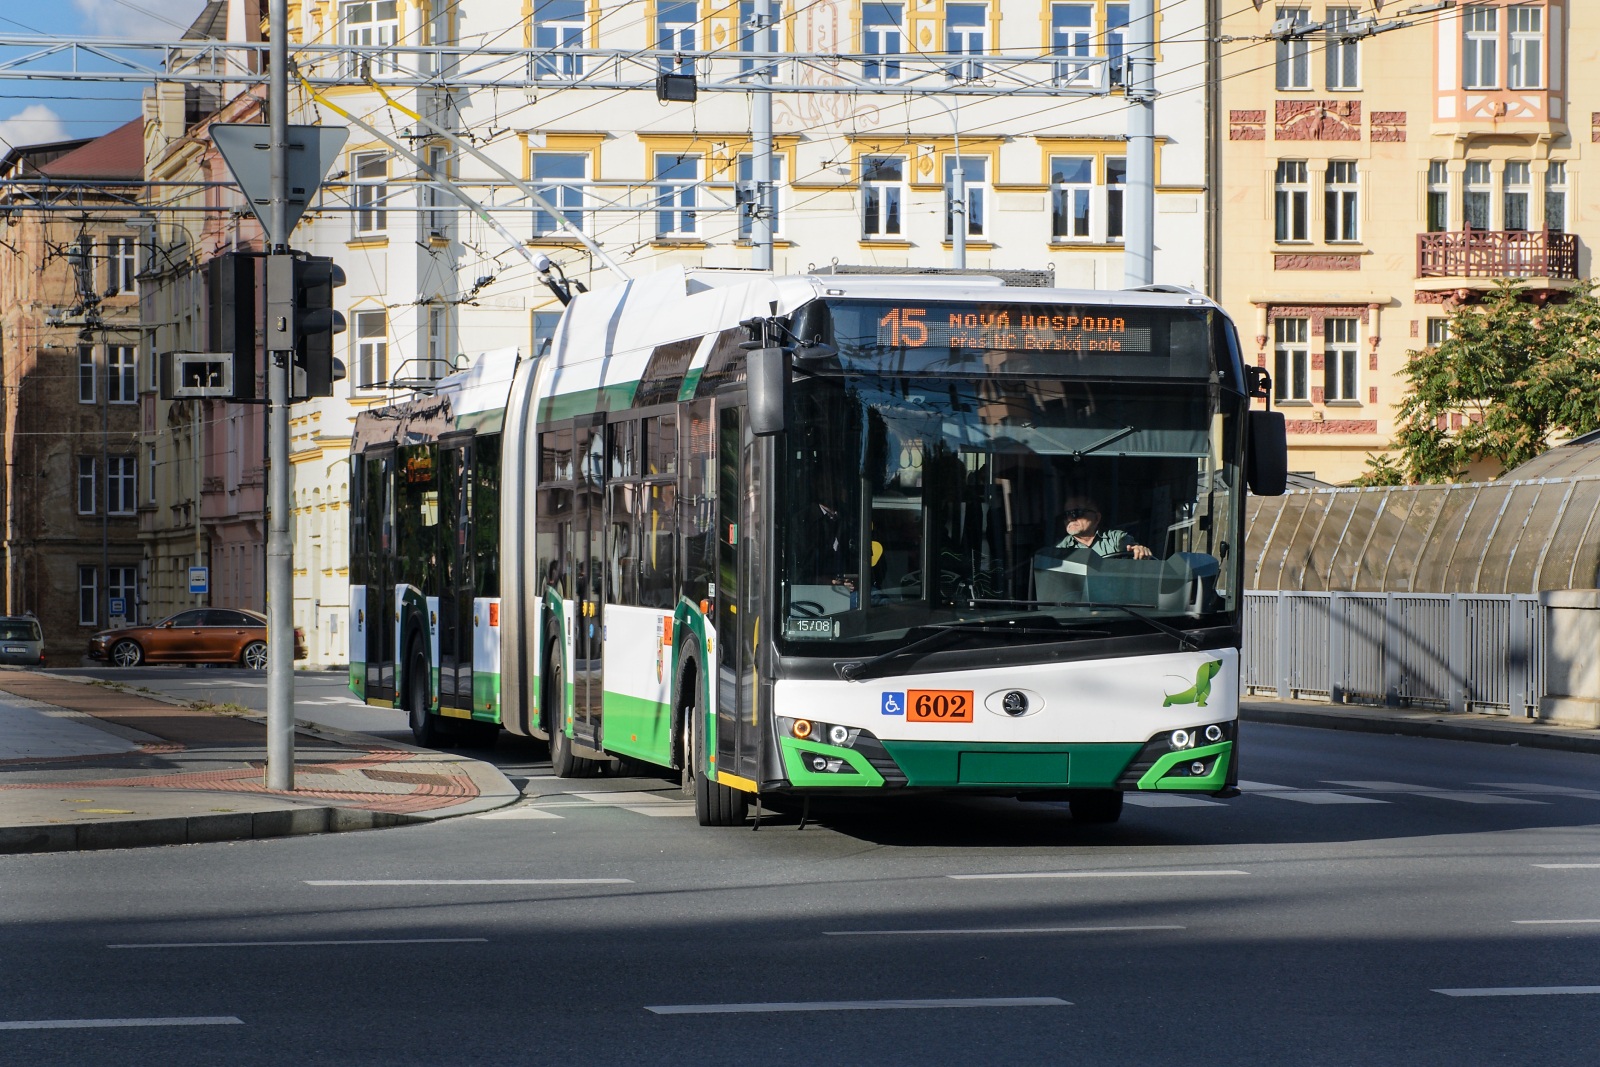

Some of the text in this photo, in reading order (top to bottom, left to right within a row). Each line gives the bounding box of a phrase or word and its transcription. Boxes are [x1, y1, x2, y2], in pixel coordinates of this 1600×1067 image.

[880, 307, 928, 347] 15
[949, 311, 1125, 332] NOVÁ HOSPODA
[1089, 336, 1121, 351] pole
[797, 620, 830, 631] 15/08
[915, 694, 966, 718] 602
